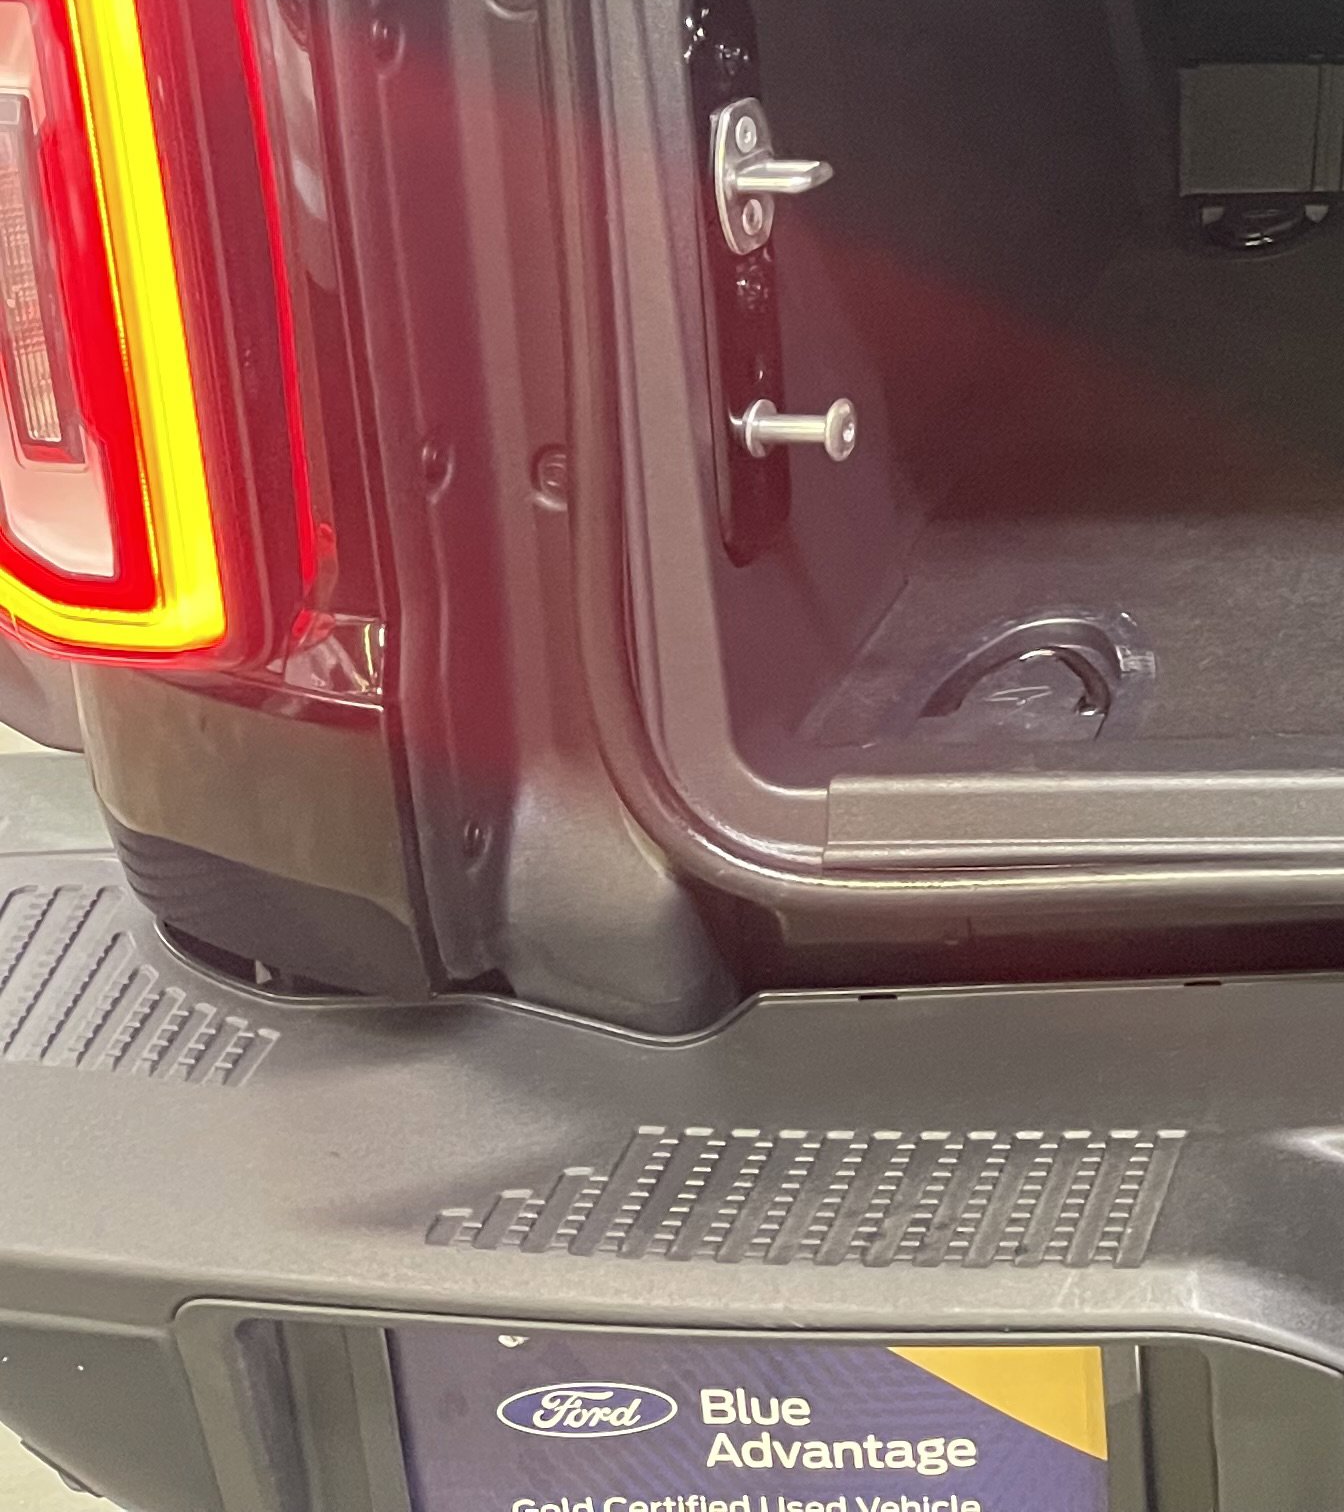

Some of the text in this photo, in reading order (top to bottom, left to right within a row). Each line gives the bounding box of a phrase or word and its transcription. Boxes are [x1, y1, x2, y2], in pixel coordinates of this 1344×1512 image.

[531, 1389, 644, 1430] Ford
[700, 1387, 811, 1426] Blue
[706, 1431, 978, 1476] Advantage
[603, 1494, 751, 1512] Certified
[854, 1494, 982, 1512] Vehicle
